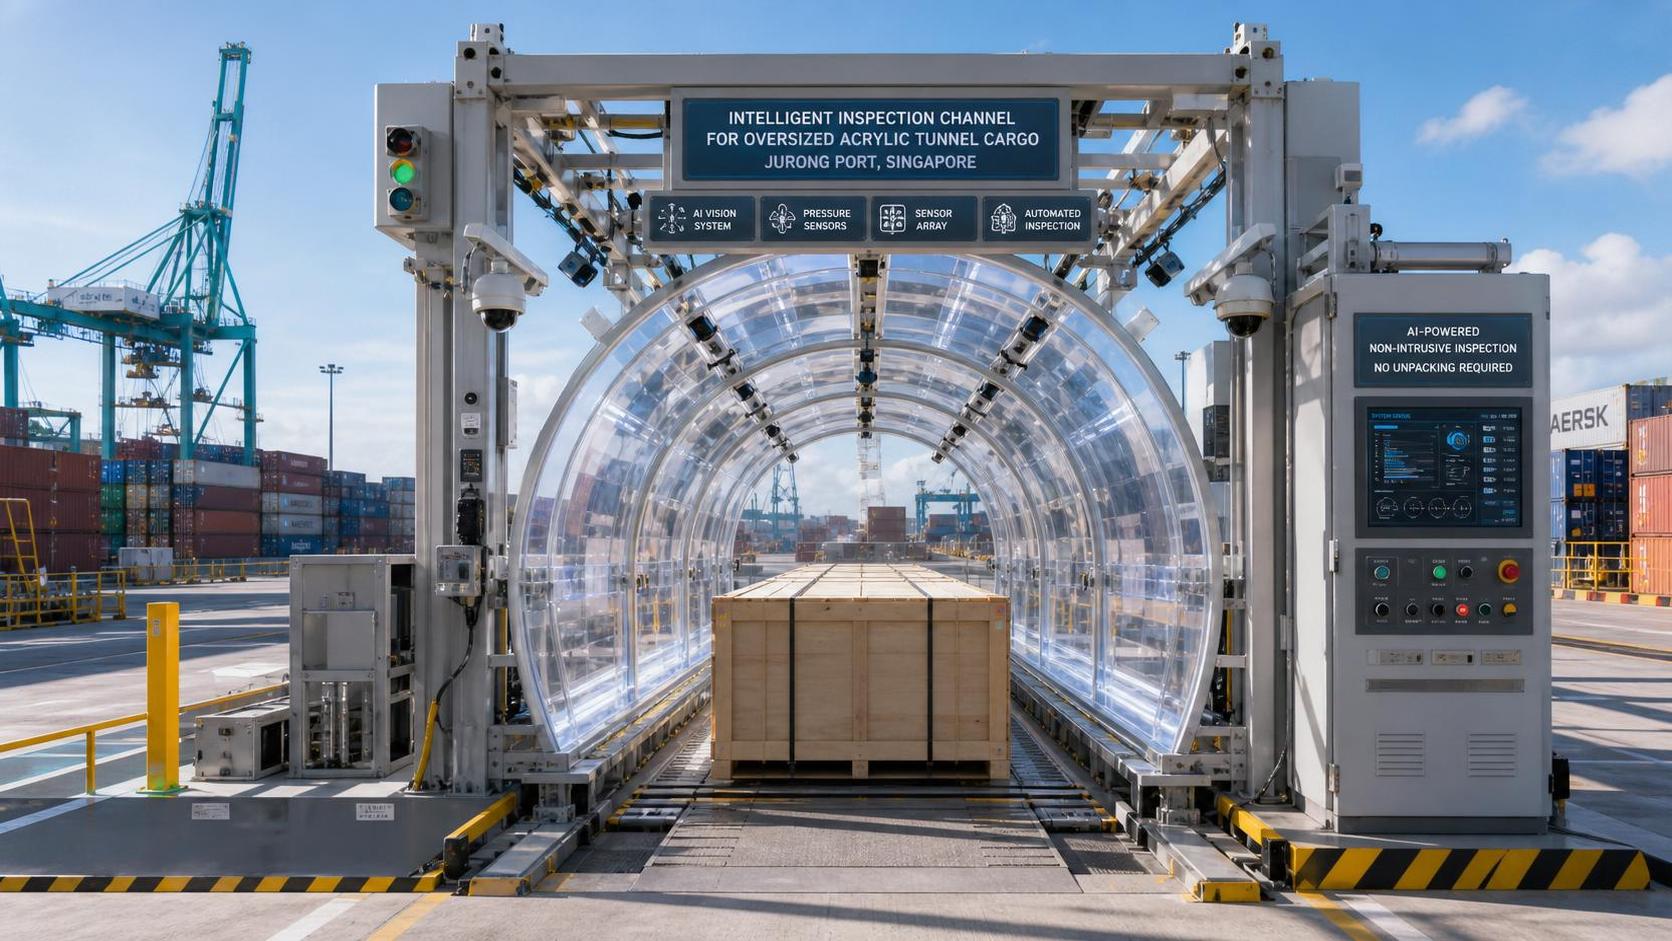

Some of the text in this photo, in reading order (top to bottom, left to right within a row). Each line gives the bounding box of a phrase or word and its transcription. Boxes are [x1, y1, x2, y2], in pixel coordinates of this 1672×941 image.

[728, 111, 1016, 125] INTELLIGENT INSPECTION CHANNEL
[706, 131, 1039, 146] FOR OVERSIZED ACRYLIC TUNNEL CARGO
[764, 154, 977, 171] JURONG PORT, SINGAPORE
[693, 209, 737, 218] AI VISION
[803, 209, 851, 218] PRESSURE
[915, 209, 953, 218] SENSOR
[1024, 209, 1081, 218] AUTOMATED
[694, 221, 732, 231] SYSTEM
[803, 221, 847, 231] SENSORS
[916, 221, 948, 231] ARRAY
[1025, 221, 1081, 231] INSPECTION
[1406, 326, 1480, 337] AI-POWERED
[1369, 343, 1517, 354] NON-INTRUSIVE INSPECTION
[1374, 362, 1513, 374] NO UNPACKING REQUIRED
[1550, 404, 1609, 433] AERSK
